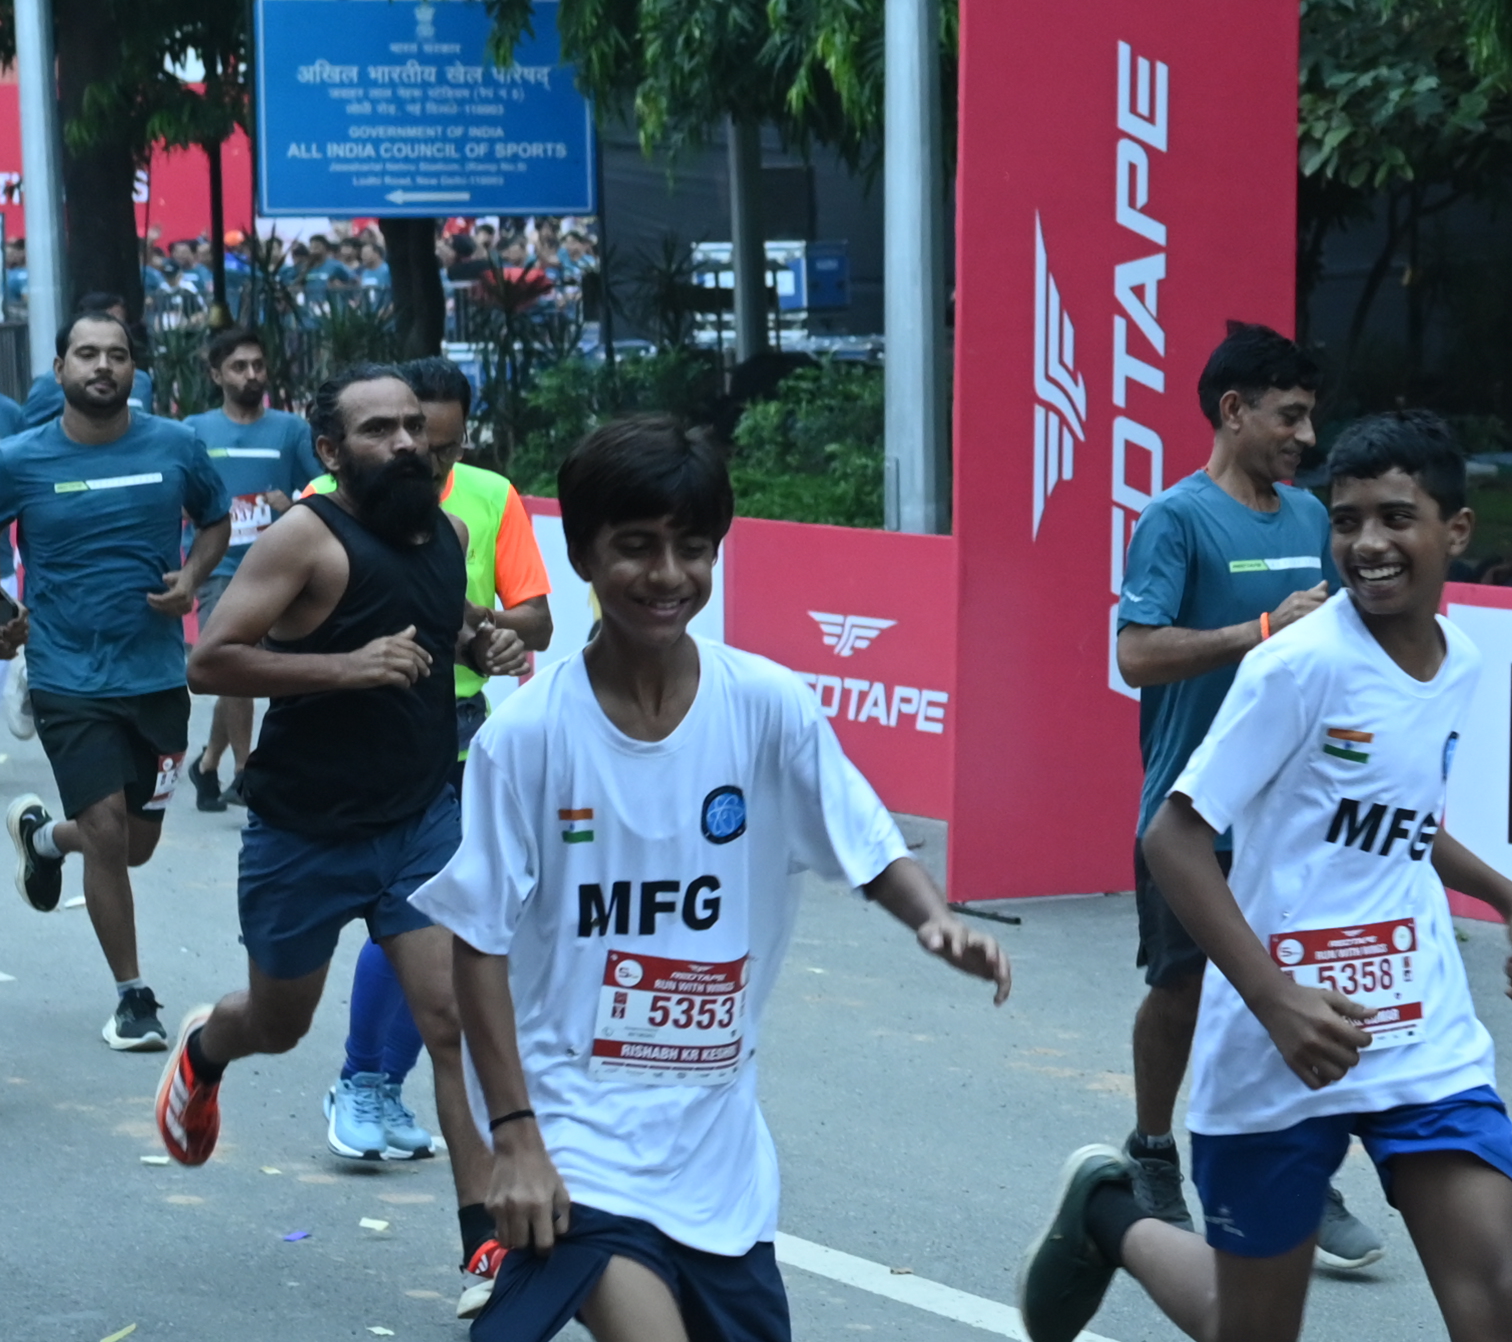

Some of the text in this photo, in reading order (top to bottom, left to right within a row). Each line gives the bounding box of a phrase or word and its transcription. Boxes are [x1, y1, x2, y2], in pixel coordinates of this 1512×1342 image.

[367, 58, 437, 85] भारतीय
[348, 125, 504, 139] GOVERNMENT OF INDIA
[287, 142, 567, 160] ALL INDIA COUNCIL OF SPORTS
[1108, 39, 1169, 702] DTAPE
[791, 670, 949, 734] DTAPE
[577, 875, 721, 937] MFG
[654, 979, 677, 990] RUN
[678, 981, 704, 993] WITH
[670, 971, 727, 981] REDTAPE
[1317, 958, 1393, 995] 5358
[648, 994, 736, 1030] 5353
[620, 1044, 679, 1060] RISHABH
[680, 1047, 700, 1061] KR
